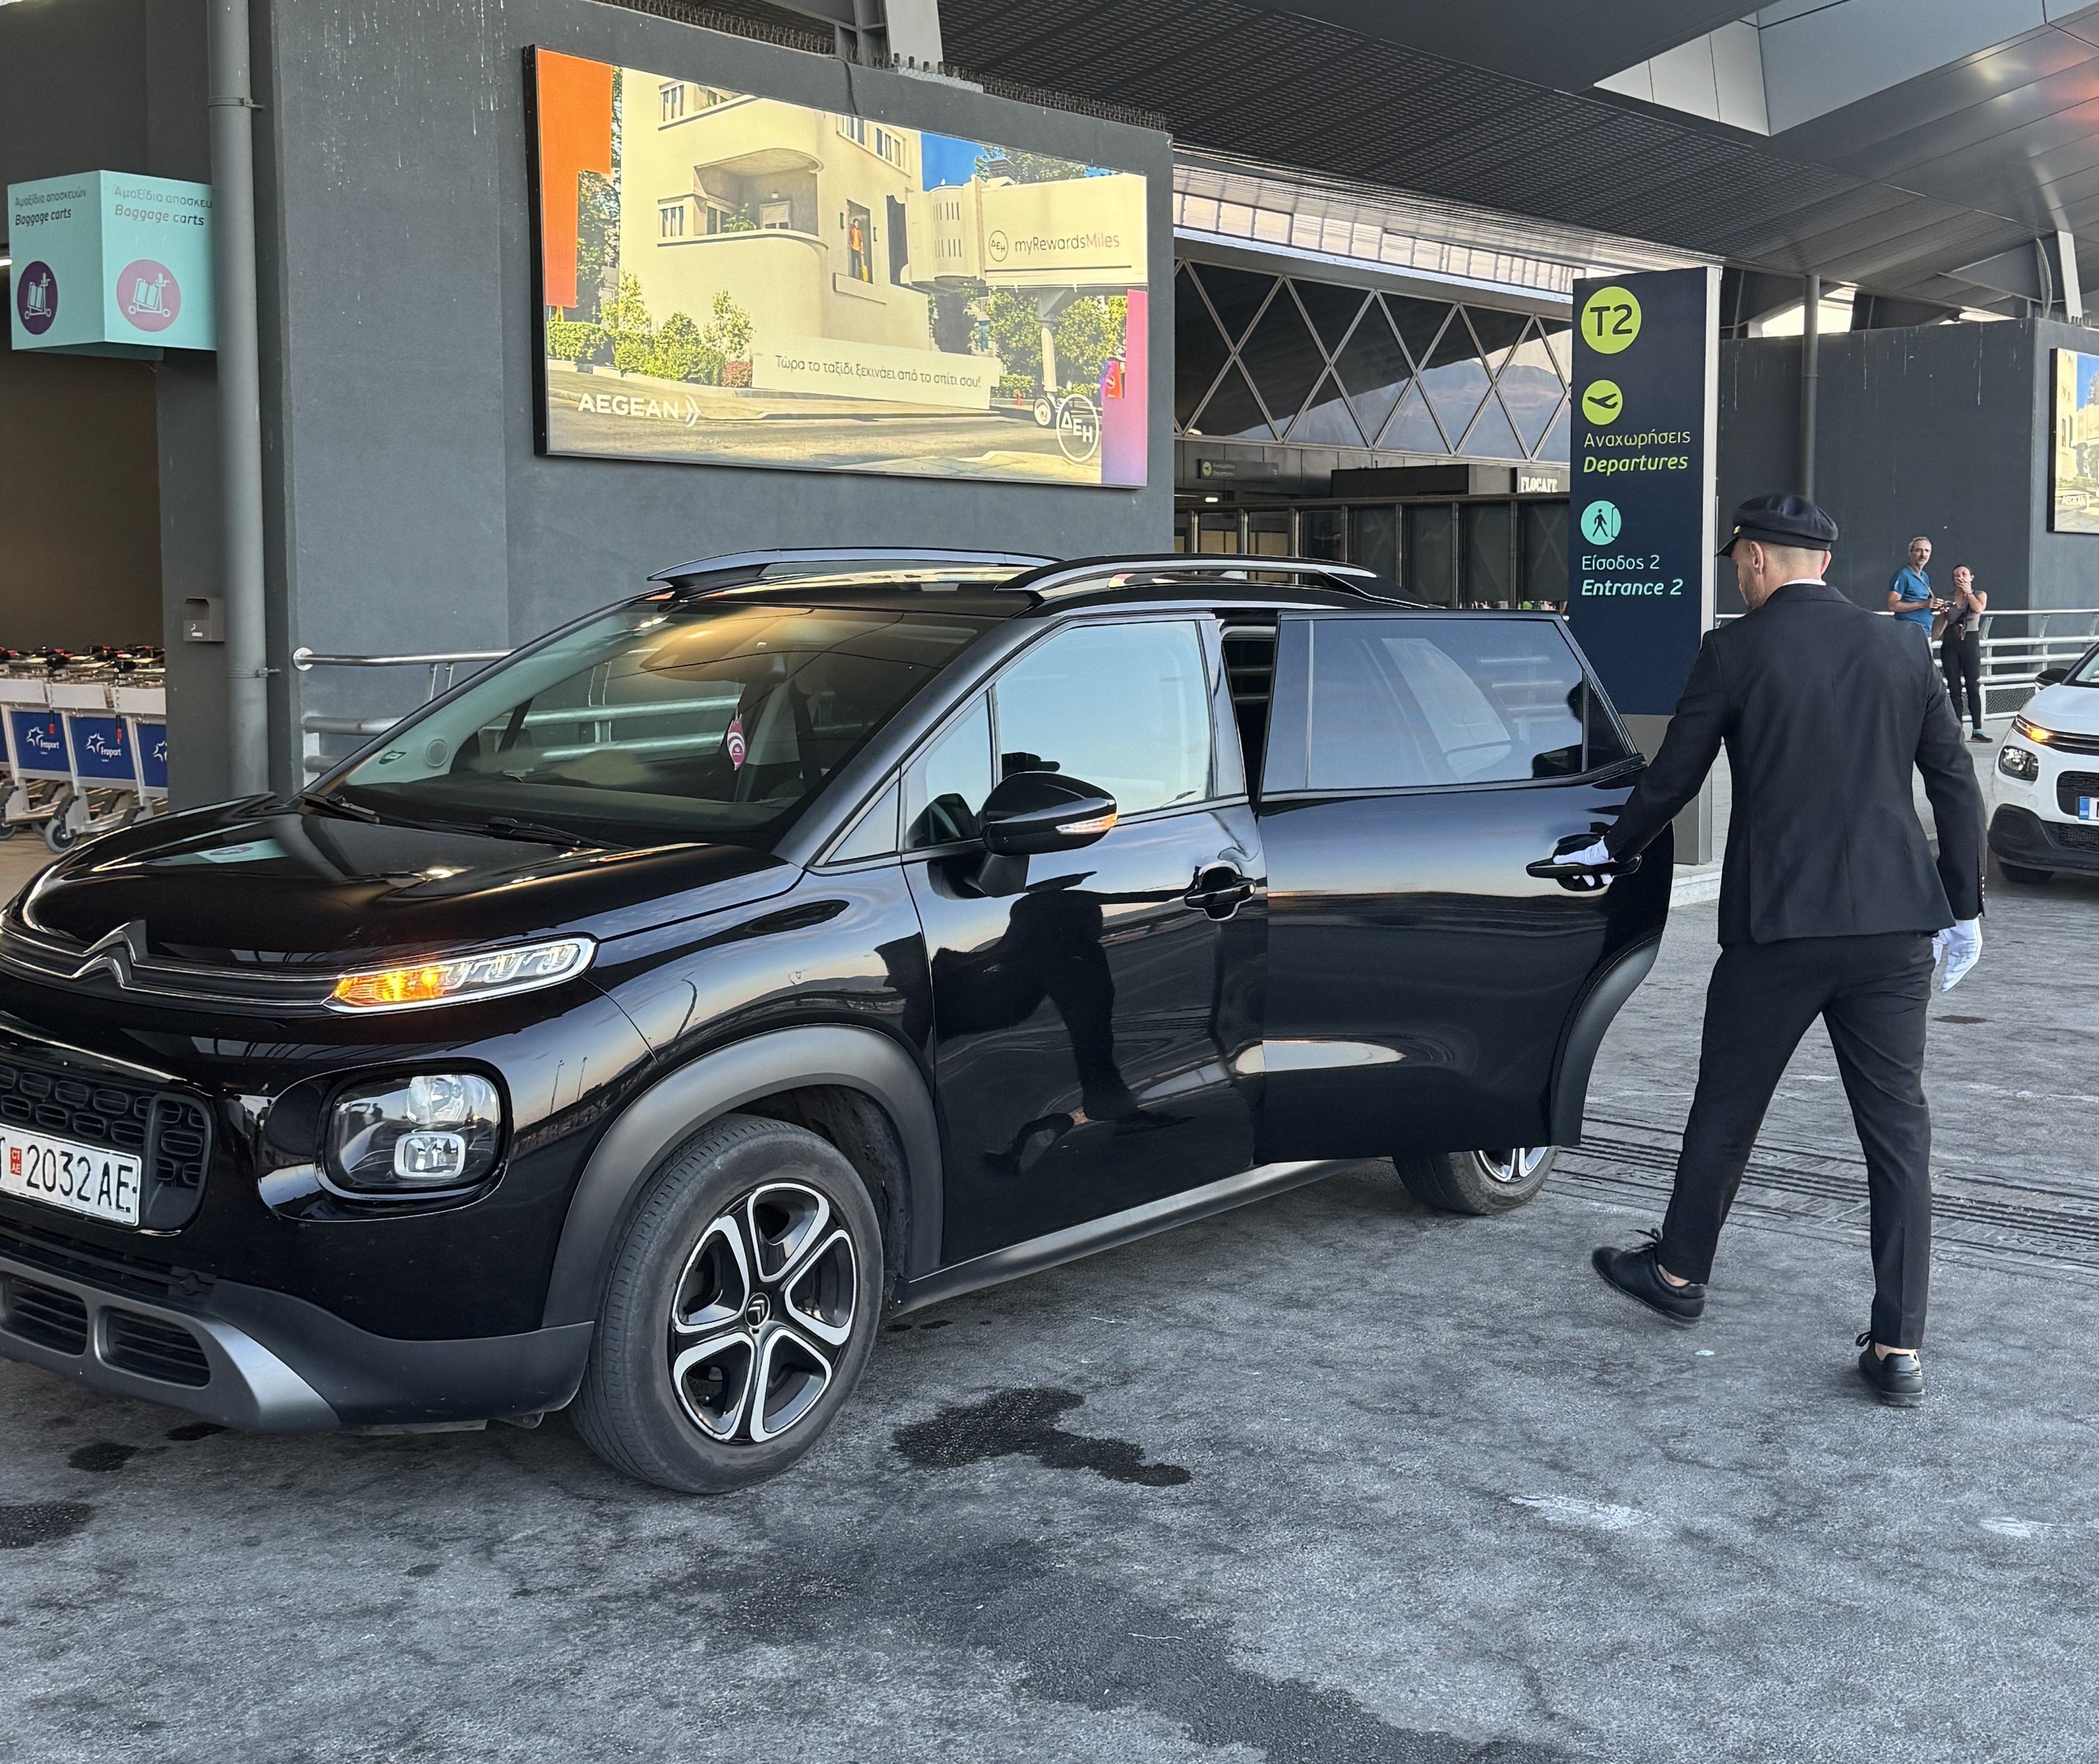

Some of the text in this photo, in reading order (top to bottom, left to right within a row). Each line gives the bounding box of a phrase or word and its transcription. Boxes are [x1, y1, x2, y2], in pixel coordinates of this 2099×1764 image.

[115, 186, 212, 208] Αμαξίδια αποσκευ
[15, 208, 72, 227] Baggage carts
[115, 204, 204, 225] Baggage carts
[1015, 233, 1120, 255] myRewardsMiles
[1590, 304, 1632, 336] T2
[775, 355, 980, 388] Τώρα το ταξίδι ξεκινάει από το σπίτι σου!
[577, 392, 679, 419] AEGEAN
[1061, 411, 1093, 443] ΔΕΗ
[1584, 428, 1690, 448] Αναχωρήσεις
[1584, 455, 1688, 476] Departures
[1520, 476, 1558, 493] FLOCAFE
[1582, 554, 1660, 570] Είσοδος 2
[1582, 578, 1684, 596] Entrance 2
[26, 1144, 91, 1202] 2032
[98, 1161, 133, 1213] AE
